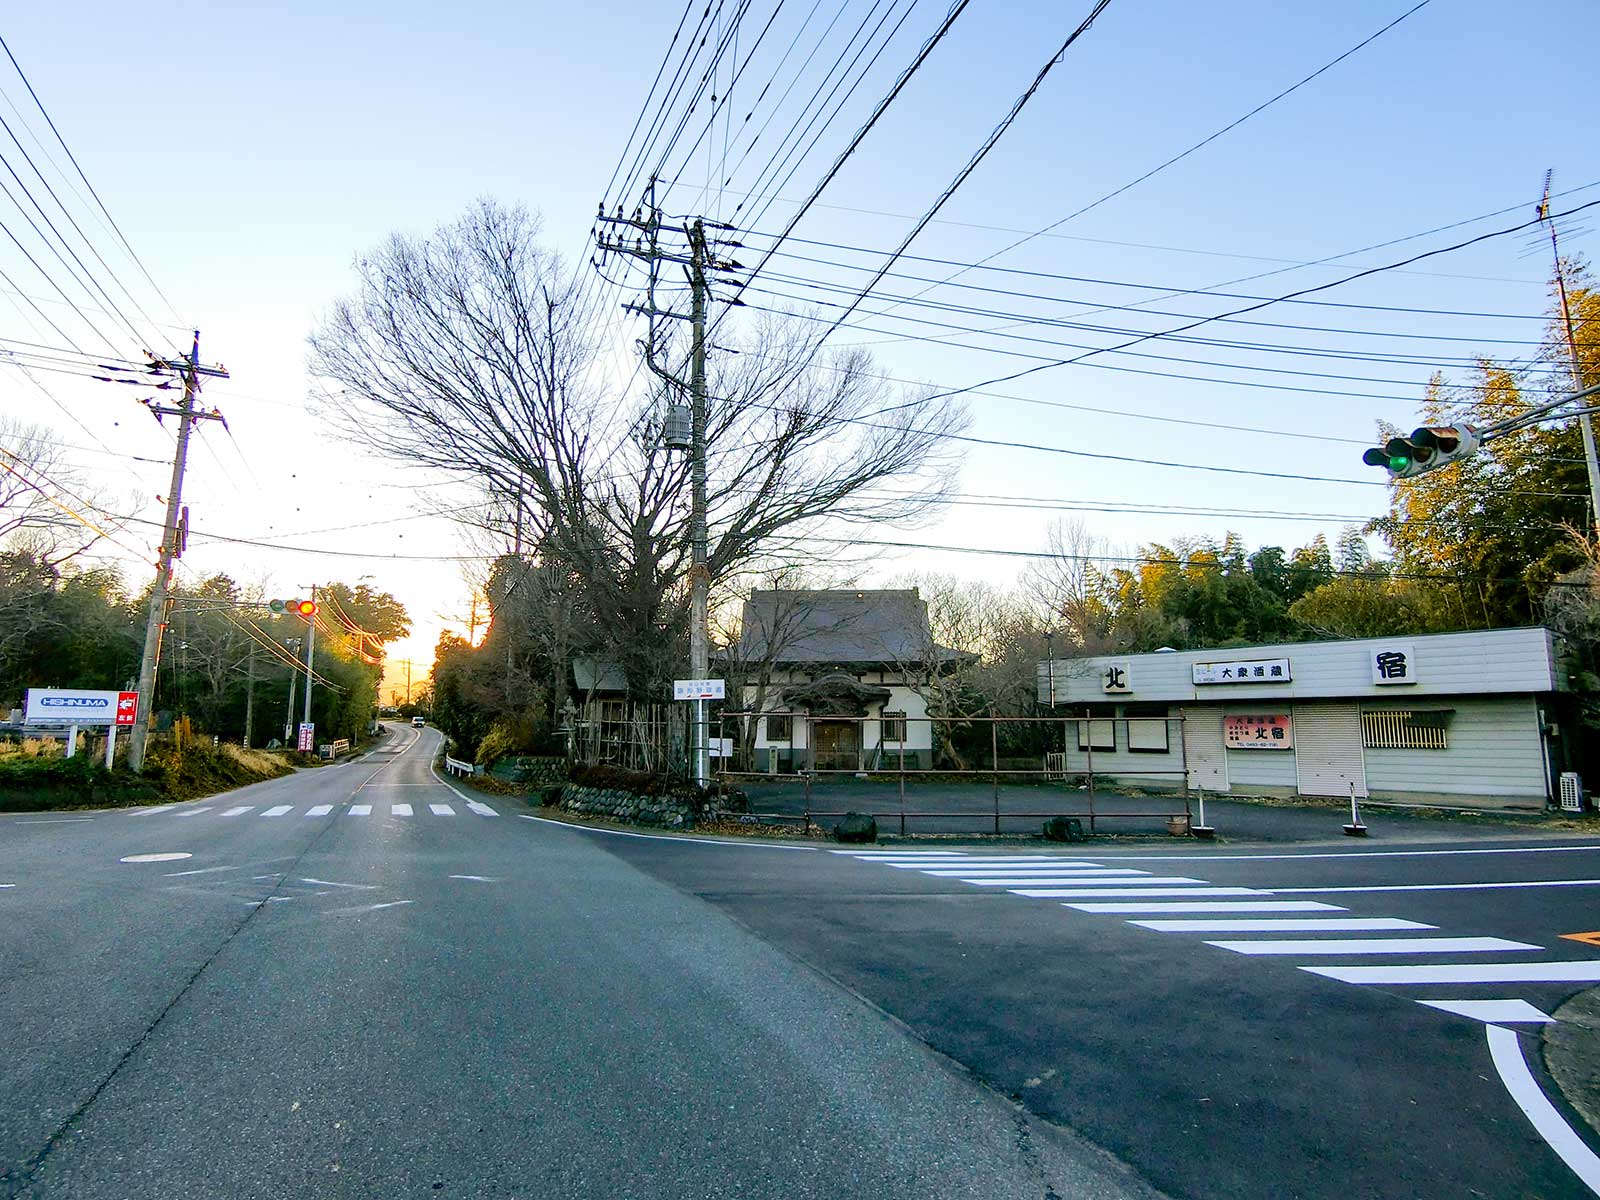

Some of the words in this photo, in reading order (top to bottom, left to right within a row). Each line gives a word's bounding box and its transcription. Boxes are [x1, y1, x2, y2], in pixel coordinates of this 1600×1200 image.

[1222, 665, 1282, 678] 大衆酒蔵
[1376, 651, 1407, 679] 宿
[1104, 666, 1126, 689] 北
[43, 698, 106, 707] HISHINUMA
[1255, 727, 1284, 739] 北宿
